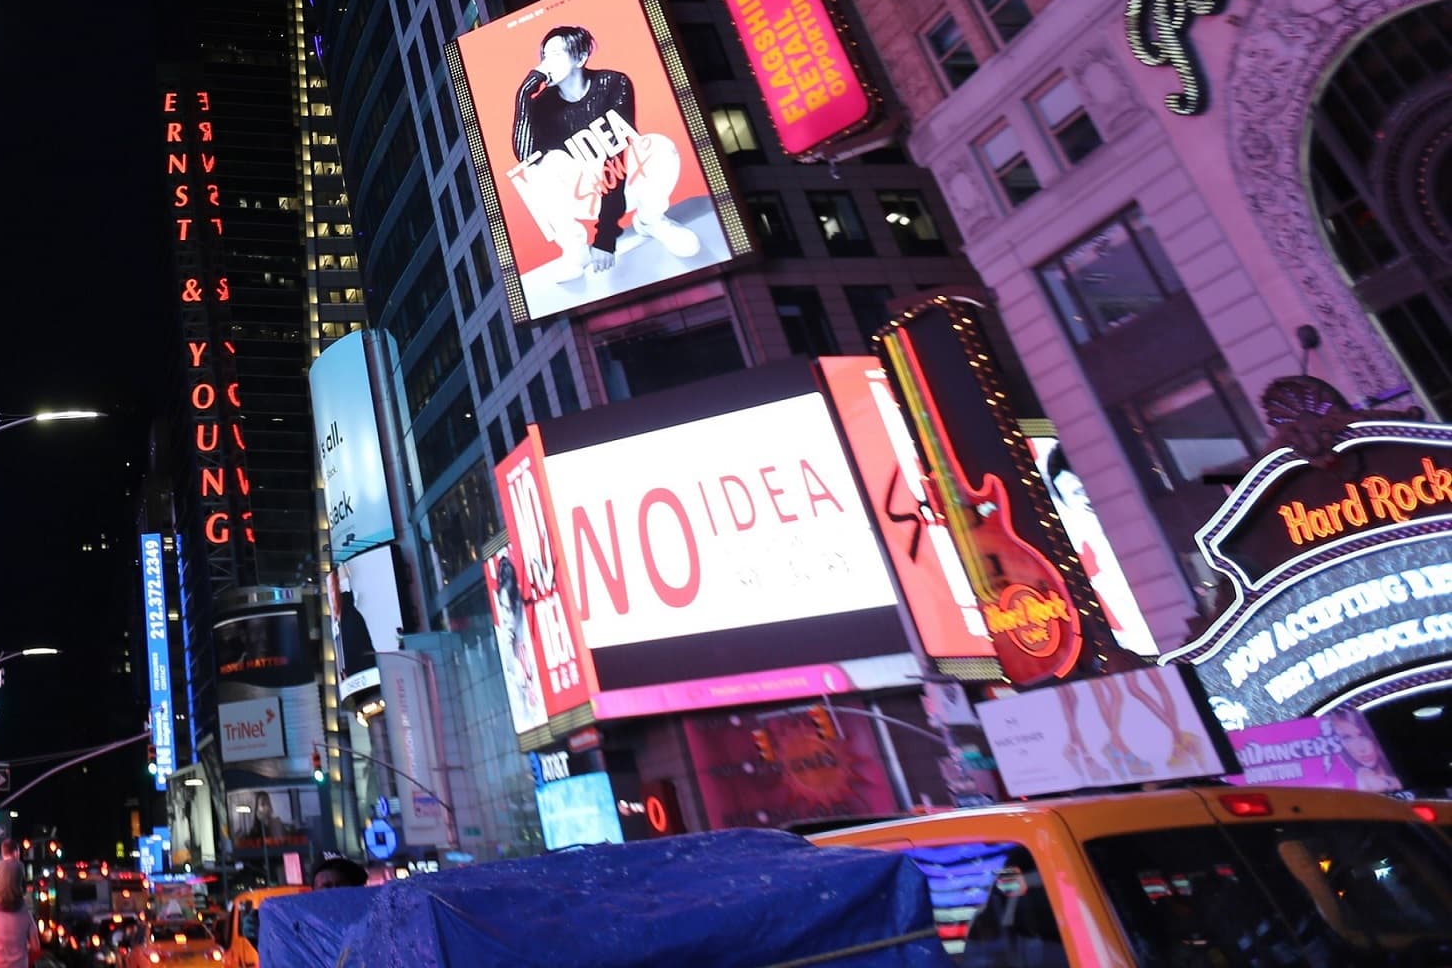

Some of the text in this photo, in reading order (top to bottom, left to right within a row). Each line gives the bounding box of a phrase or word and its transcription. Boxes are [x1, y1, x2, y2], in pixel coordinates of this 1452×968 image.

[773, 7, 831, 113] RETAIL
[164, 92, 230, 545] ERNST & YOUNG
[571, 458, 845, 622] NO IDEA
[1278, 457, 1452, 545] Hard Rock
[145, 540, 165, 640] 212.372.2349
[1222, 631, 1276, 688] NOW
[1272, 575, 1409, 651] ACCEPTING
[223, 720, 266, 741] TriNet
